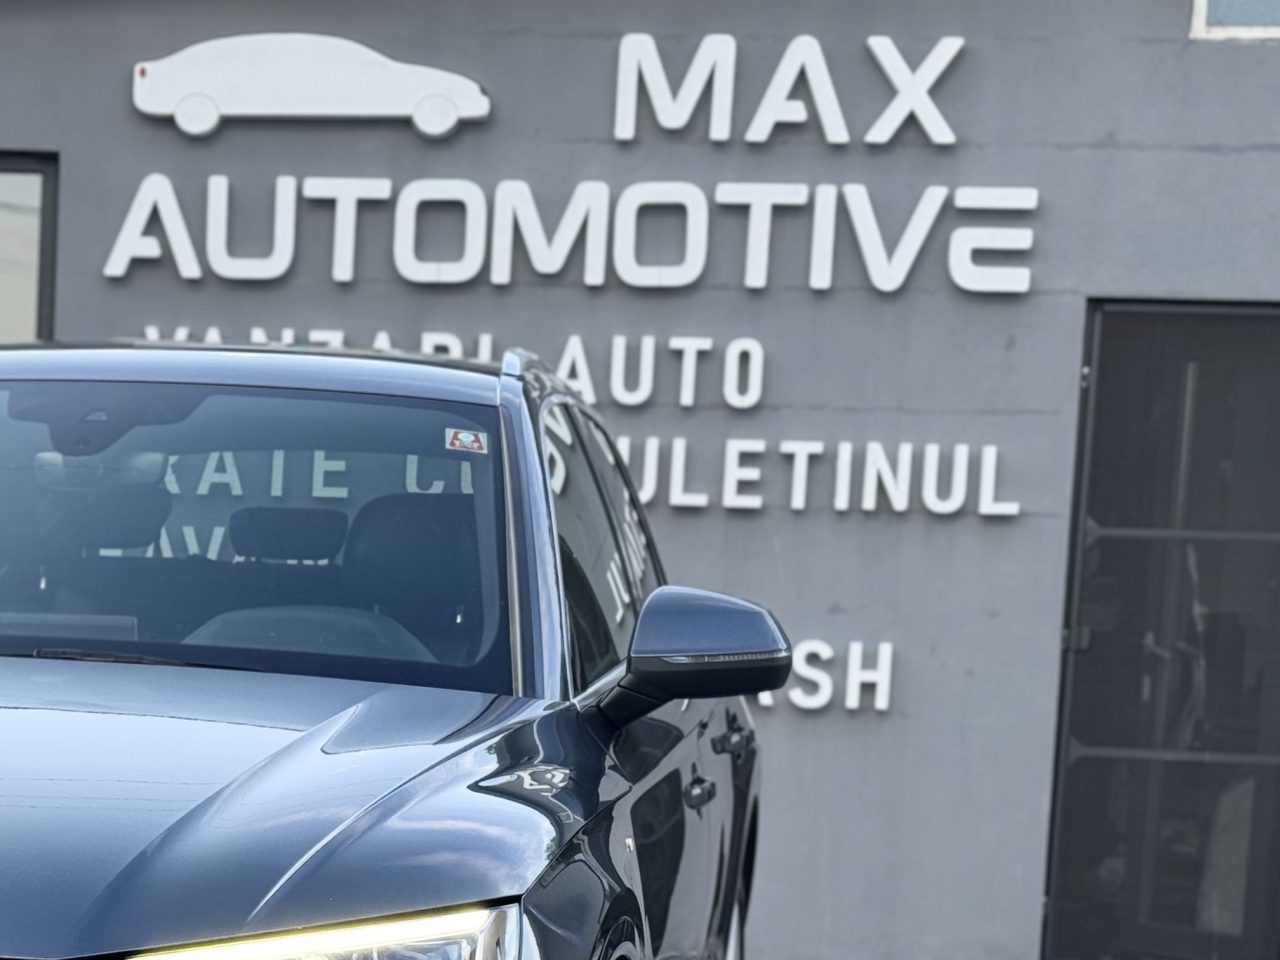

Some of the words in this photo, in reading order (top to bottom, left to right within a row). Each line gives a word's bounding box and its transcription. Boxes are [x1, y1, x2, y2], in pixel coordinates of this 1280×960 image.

[614, 32, 966, 144] MAX
[104, 173, 1039, 293] AUTOMOTIVE
[554, 334, 765, 408] AUTO
[615, 435, 1022, 516] ULETINUL
